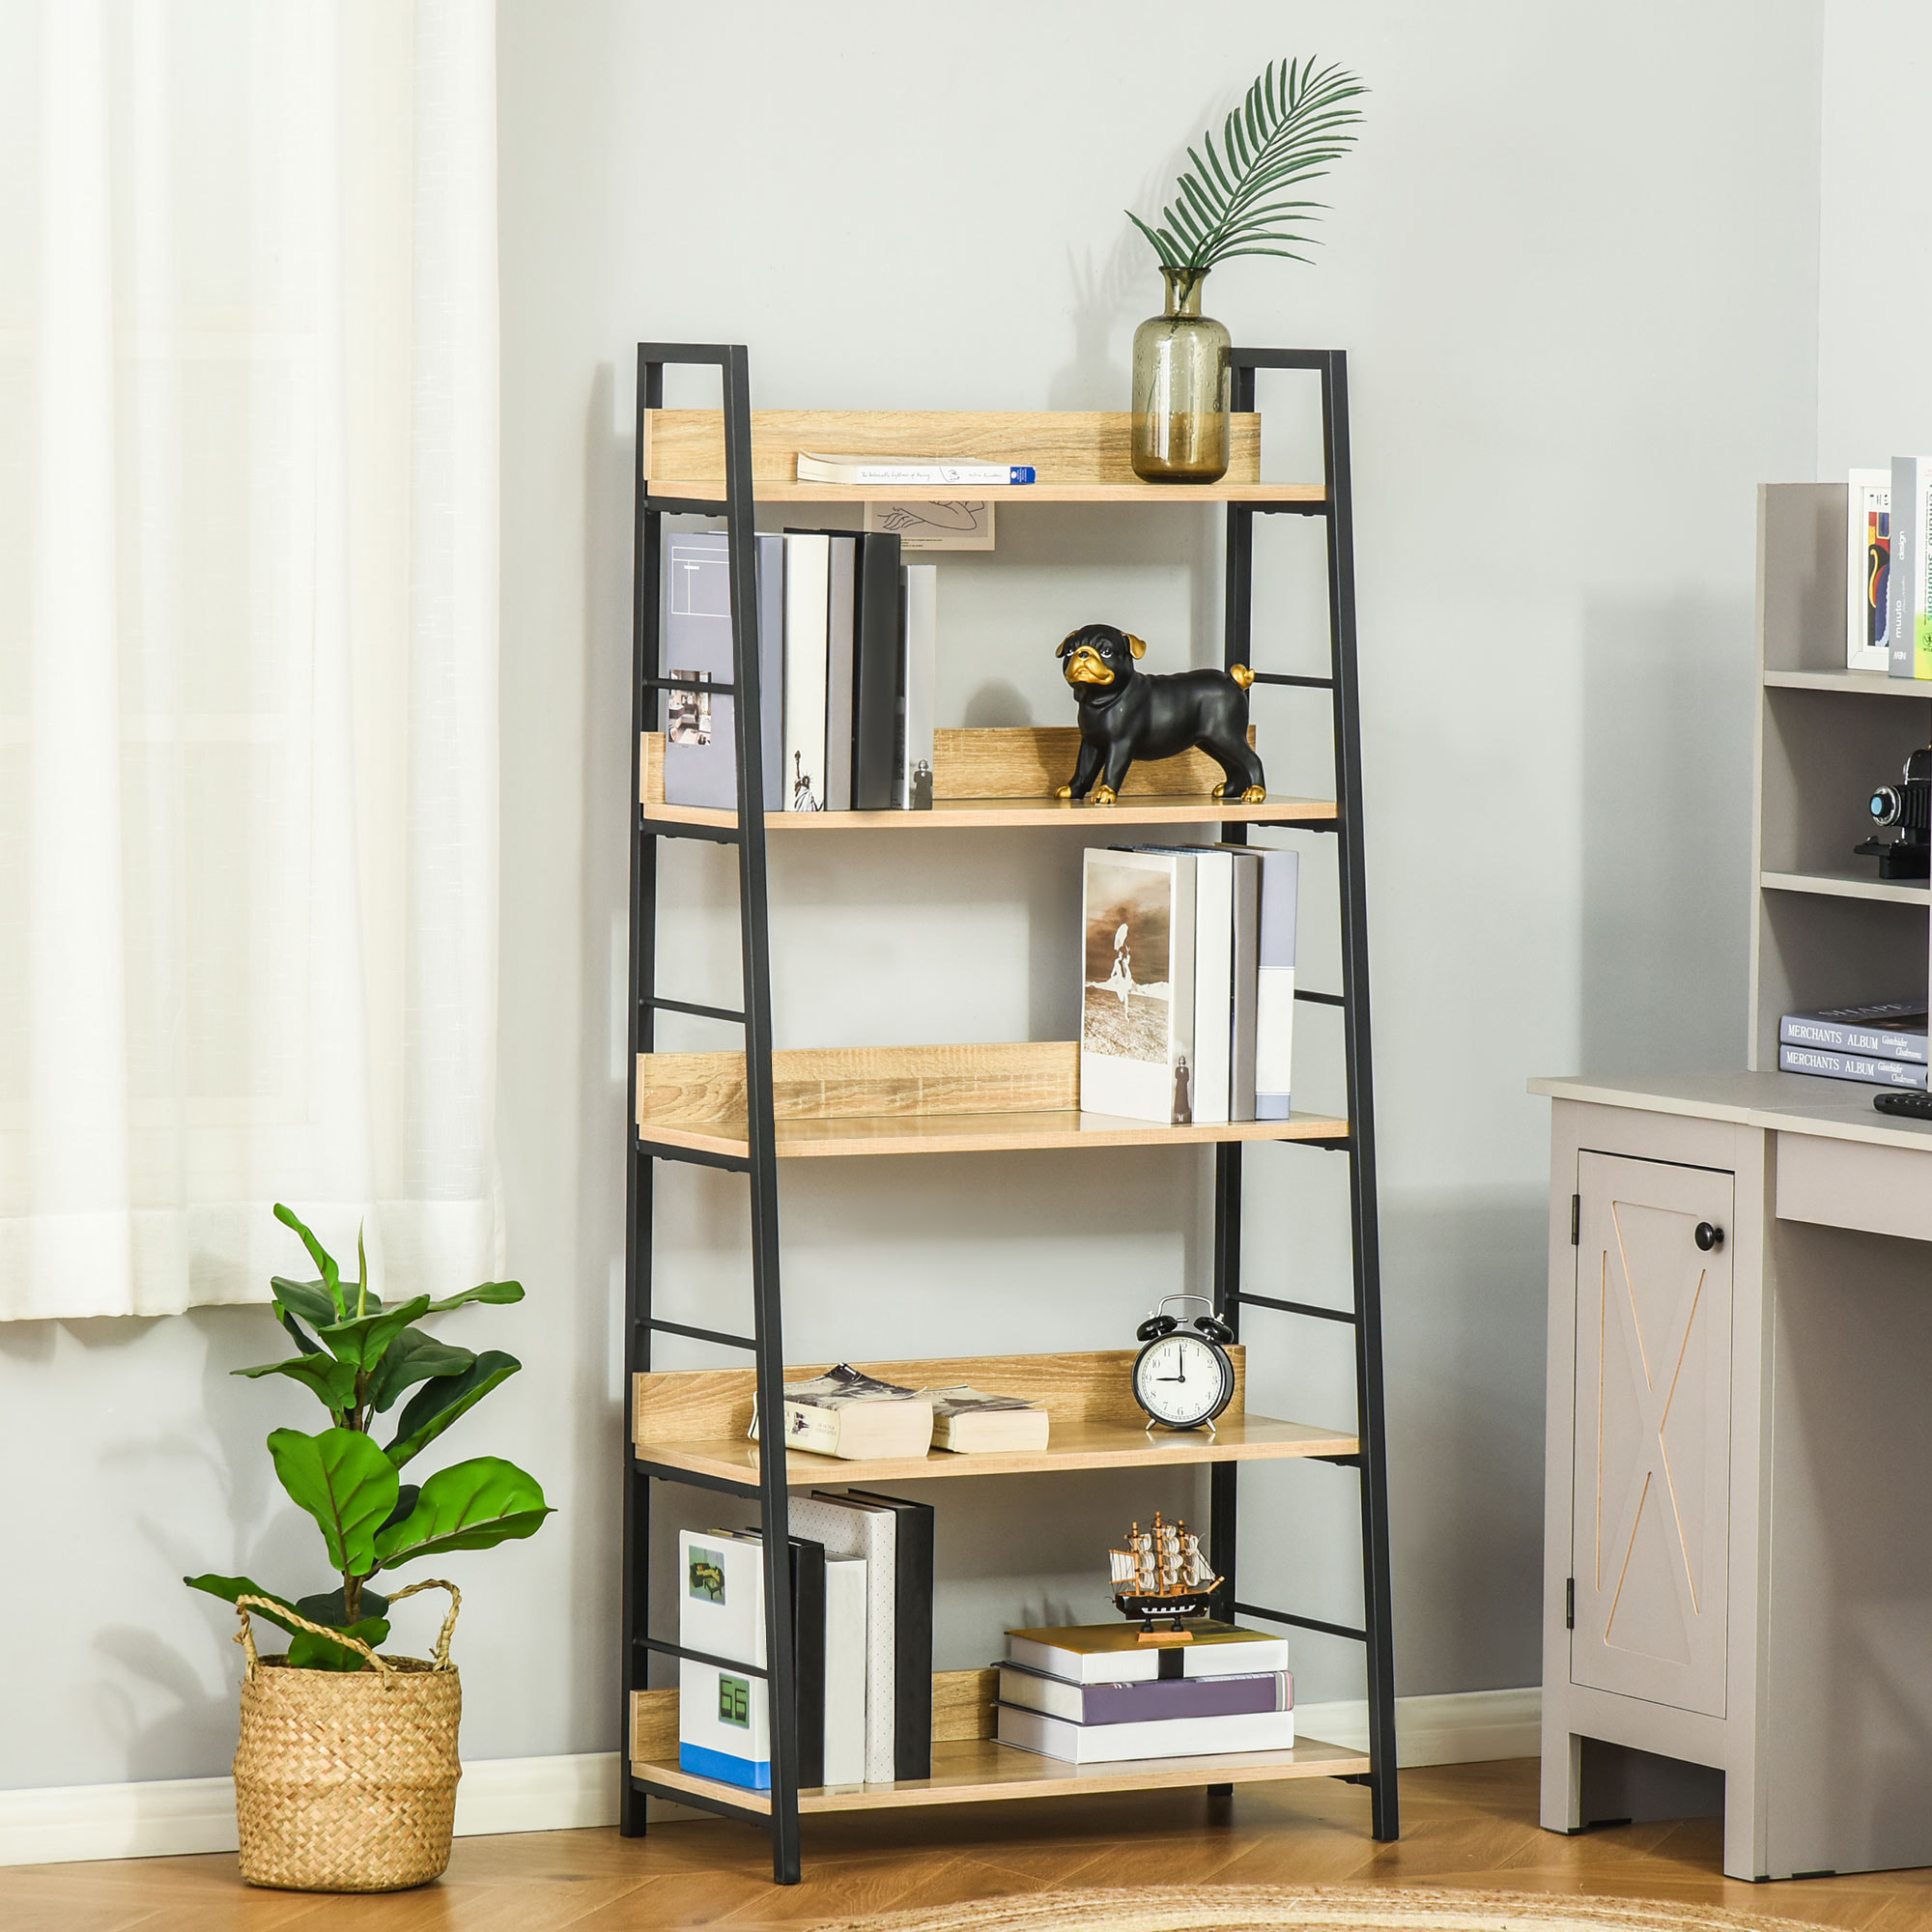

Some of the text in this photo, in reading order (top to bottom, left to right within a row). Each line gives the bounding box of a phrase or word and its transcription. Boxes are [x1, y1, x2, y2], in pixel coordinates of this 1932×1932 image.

[1788, 1024, 1878, 1050] MERCHANTS ALBUM
[1786, 1051, 1875, 1076] MERCHANTS ALBUM
[1163, 1348, 1171, 1357] 11
[1151, 1359, 1161, 1369] 10
[1207, 1359, 1213, 1369] 2
[1145, 1374, 1152, 1383] 9
[1211, 1376, 1218, 1385] 3
[1150, 1390, 1157, 1399] 8
[1206, 1391, 1211, 1400] 4
[1162, 1401, 1169, 1410] 7
[1193, 1403, 1201, 1412] 5
[1177, 1406, 1184, 1416] 6
